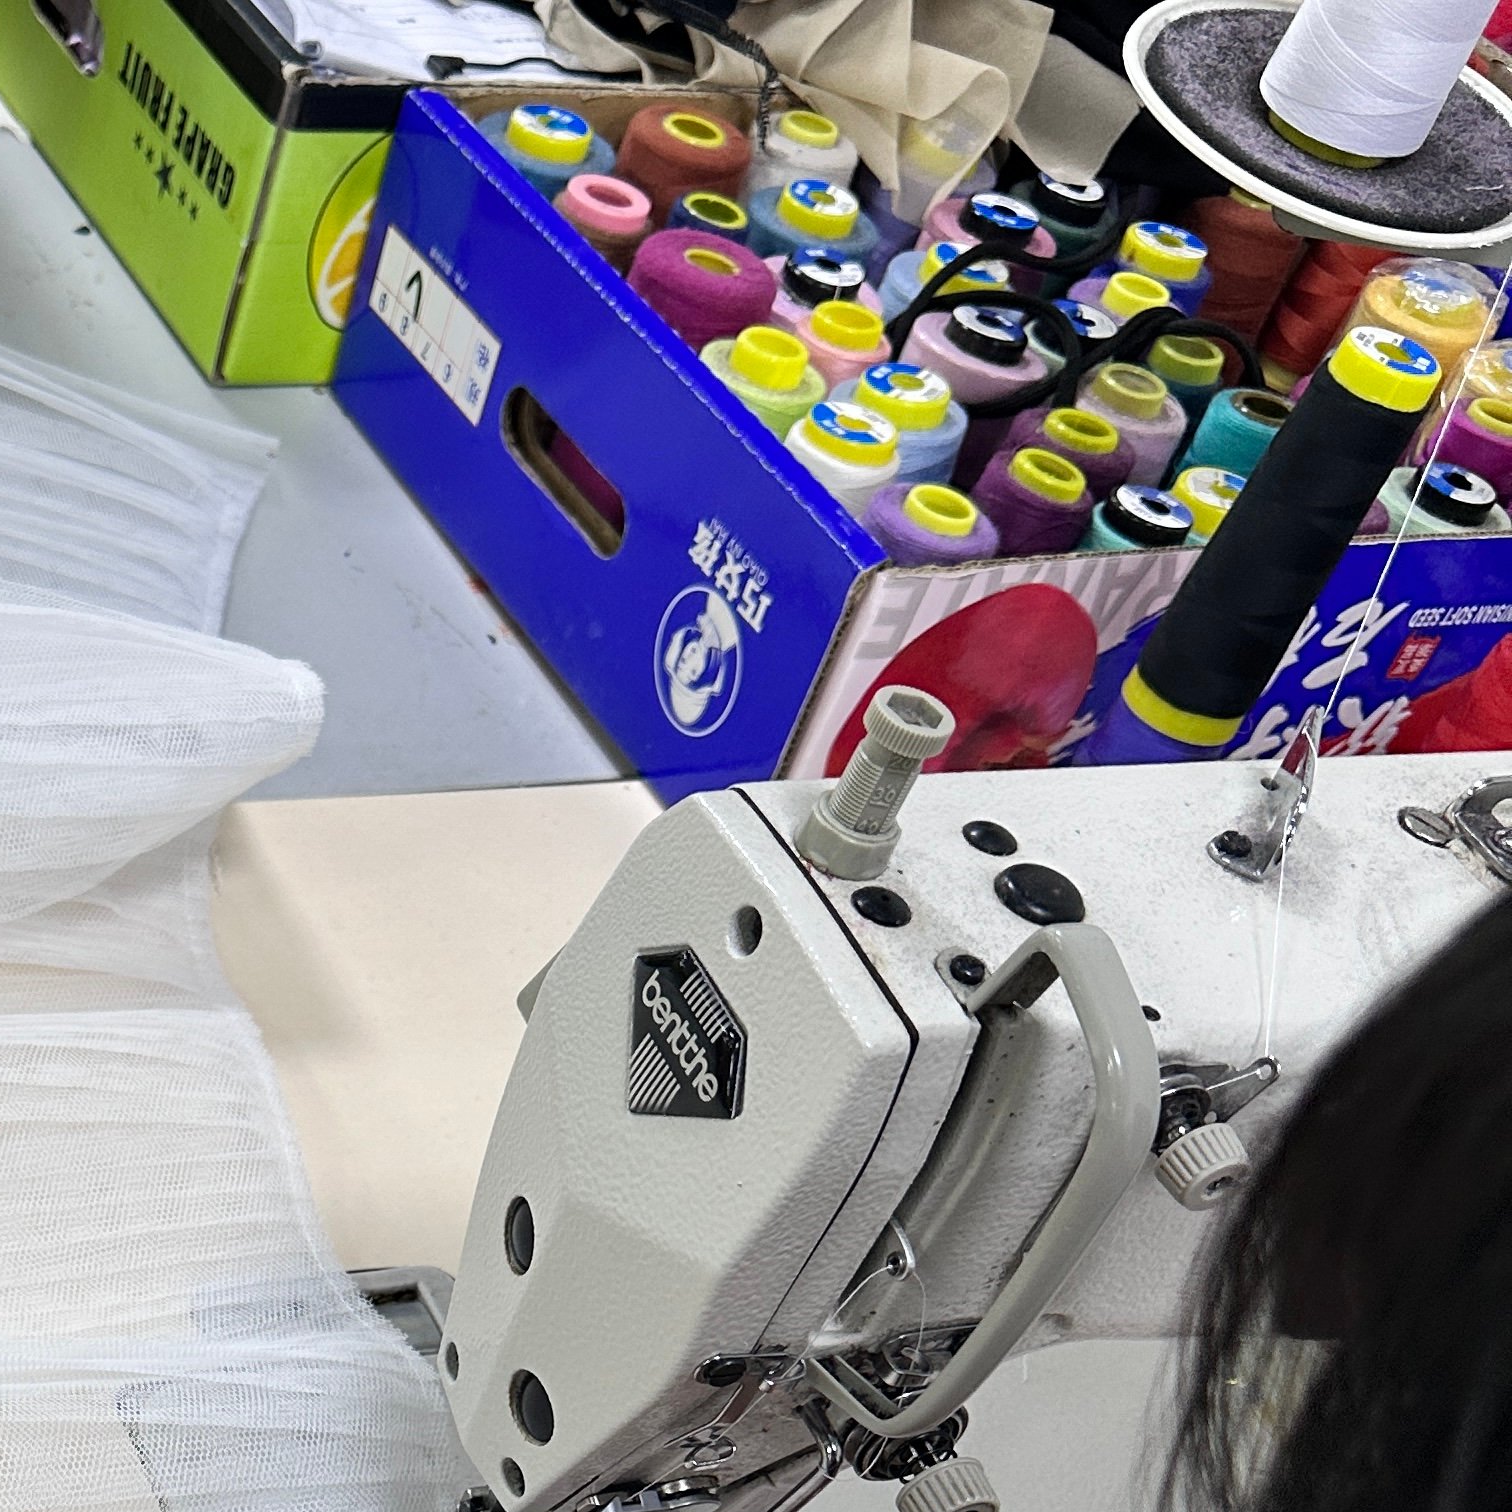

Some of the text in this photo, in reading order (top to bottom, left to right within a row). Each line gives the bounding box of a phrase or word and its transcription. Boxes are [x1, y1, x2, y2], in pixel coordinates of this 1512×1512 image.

[118, 40, 238, 210] GRAPE FRUIT
[420, 341, 432, 361] 7
[1408, 607, 1445, 628] SEED
[1439, 605, 1477, 627] SOFT
[871, 786, 896, 803] 30
[642, 969, 718, 1102] bentthe
